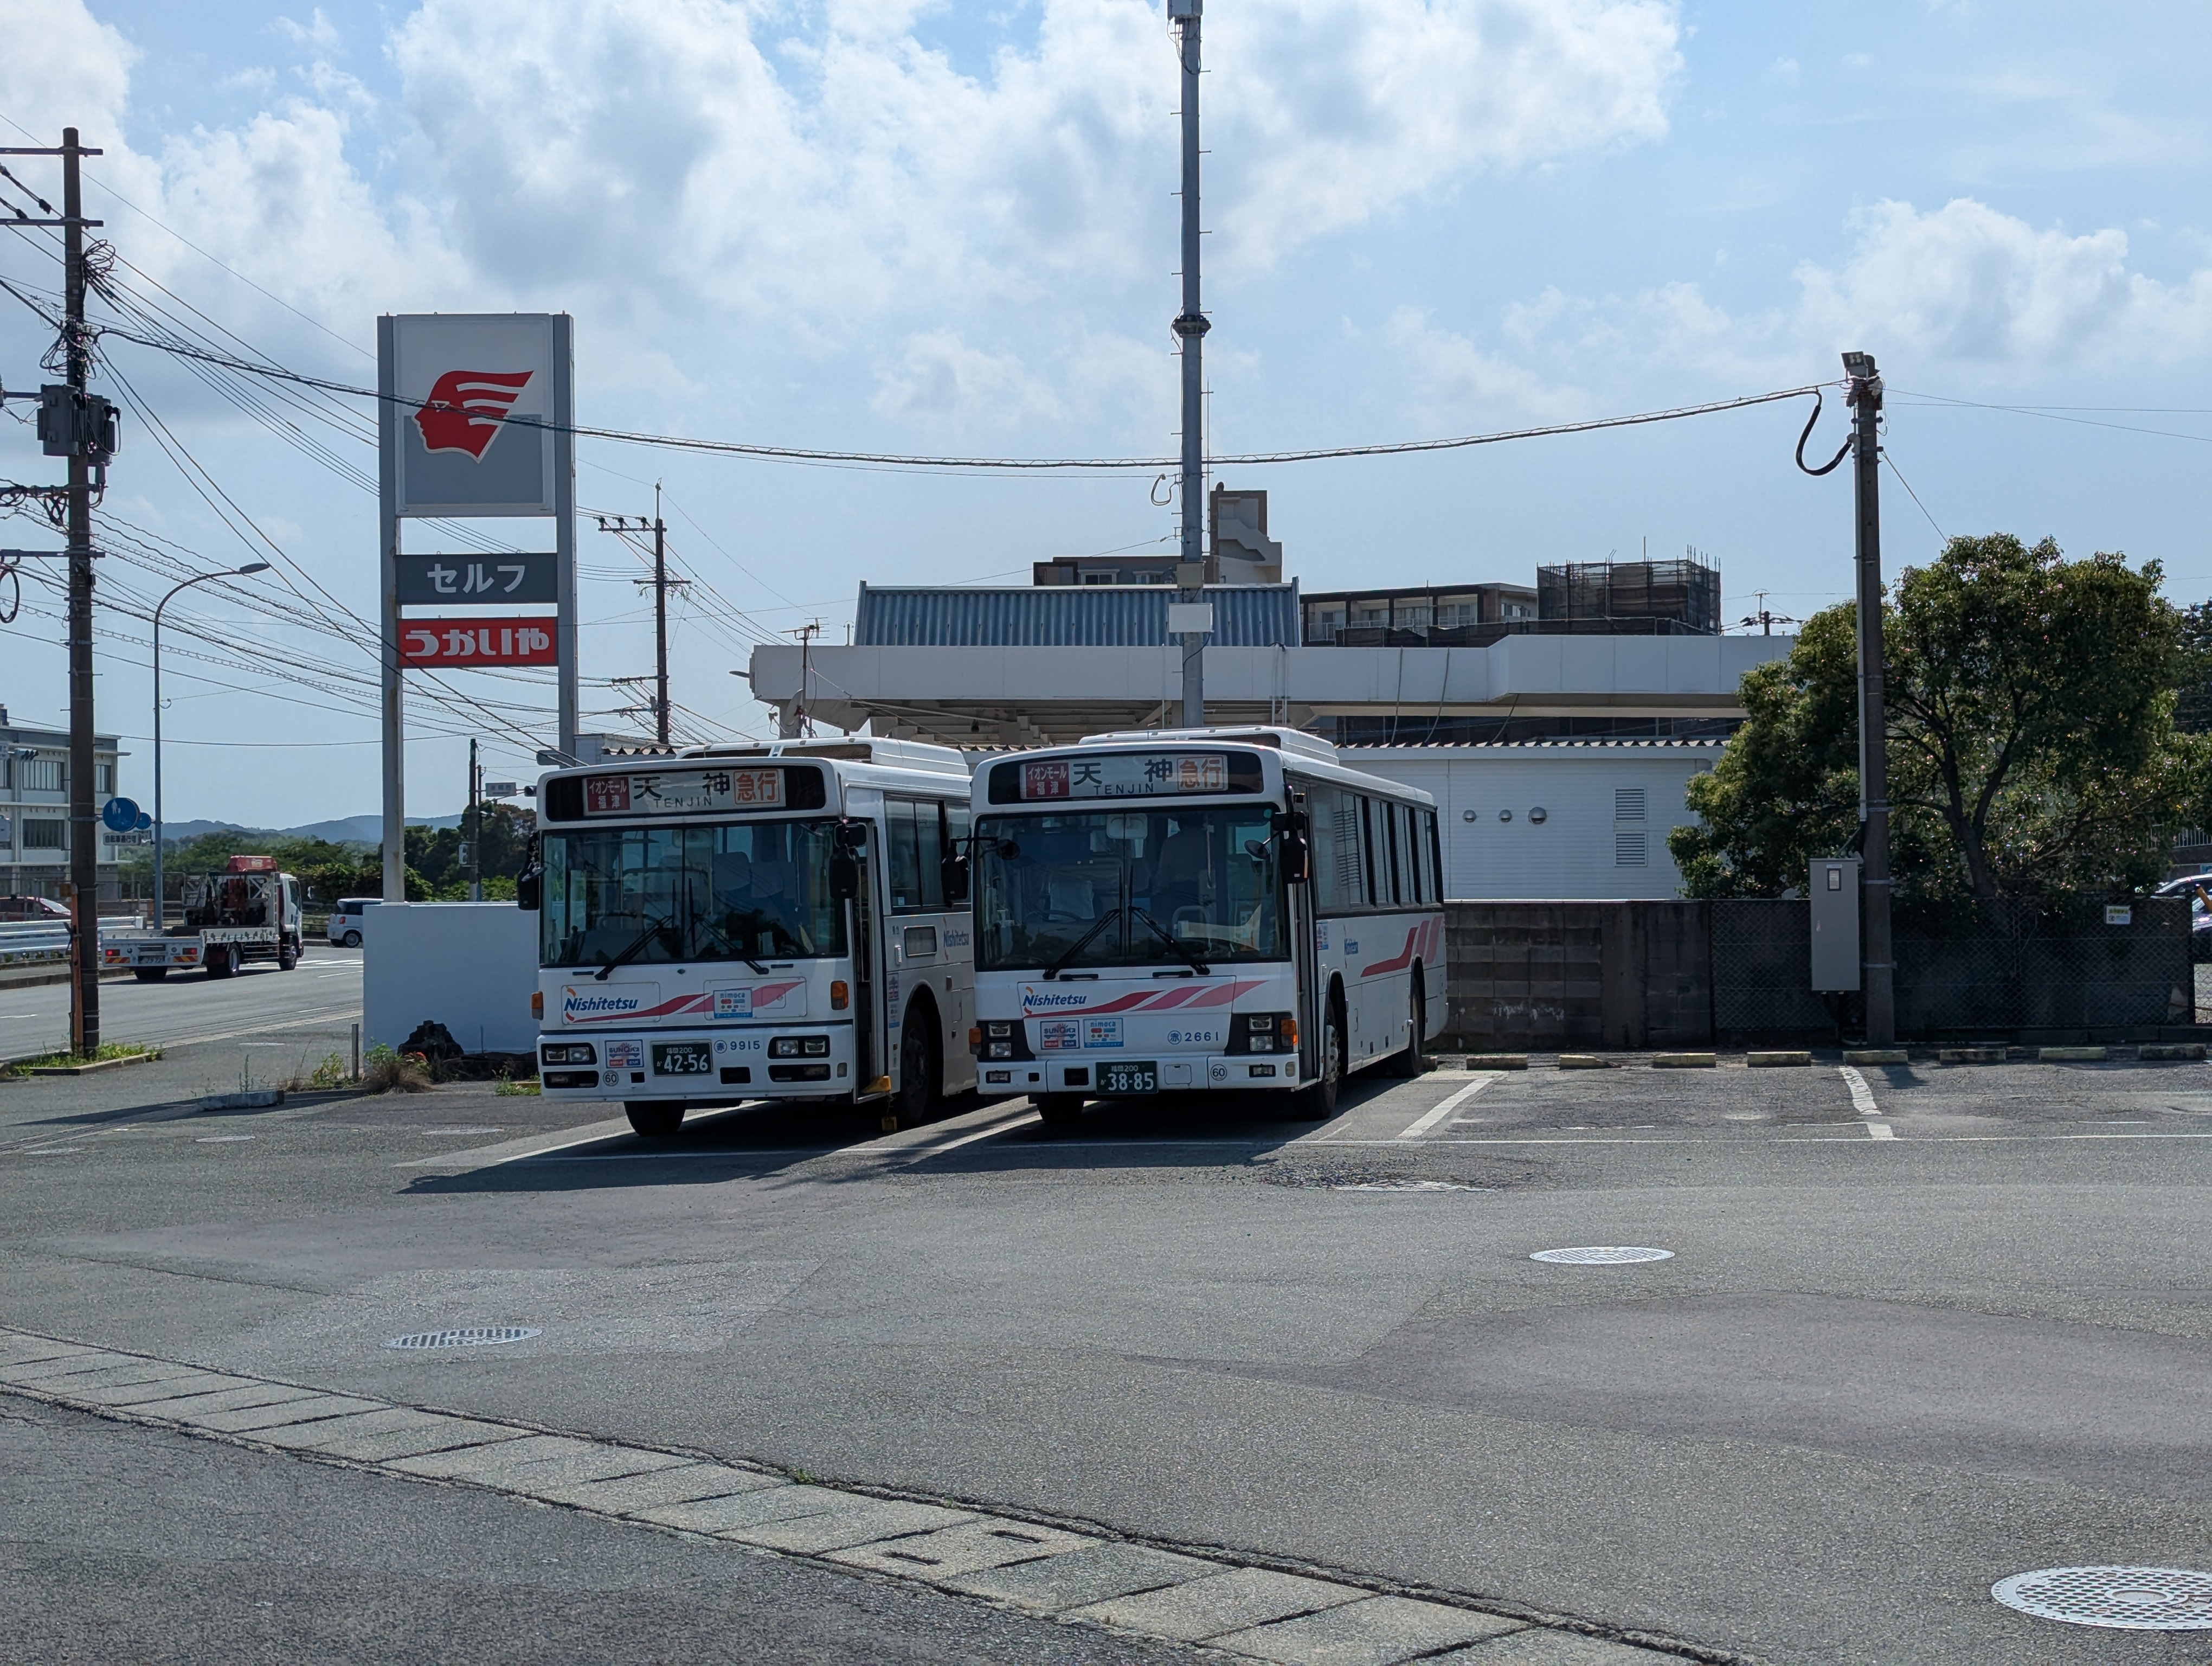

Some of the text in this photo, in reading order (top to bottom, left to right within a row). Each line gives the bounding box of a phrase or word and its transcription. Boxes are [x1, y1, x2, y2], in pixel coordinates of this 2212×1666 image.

[427, 563, 526, 593] セルフ
[405, 627, 549, 657] うかいや
[1028, 766, 1067, 781] イオンモール
[1179, 759, 1221, 789] 急行
[589, 780, 627, 794] イオンモール
[736, 772, 777, 802] 急行
[1037, 781, 1059, 796] 福津
[1094, 783, 1154, 796] TENJIN
[597, 795, 620, 809] 福津
[653, 796, 712, 809] TENJIN
[564, 997, 639, 1011] Nishitetsu
[1022, 994, 1087, 1007] Nishitetsu
[1184, 1031, 1219, 1042] 2661
[730, 1041, 761, 1050] 9915
[664, 1053, 709, 1072] 42-56
[605, 1074, 617, 1083] 60
[1212, 1068, 1225, 1077] 60
[1107, 1072, 1154, 1091] 38-85
